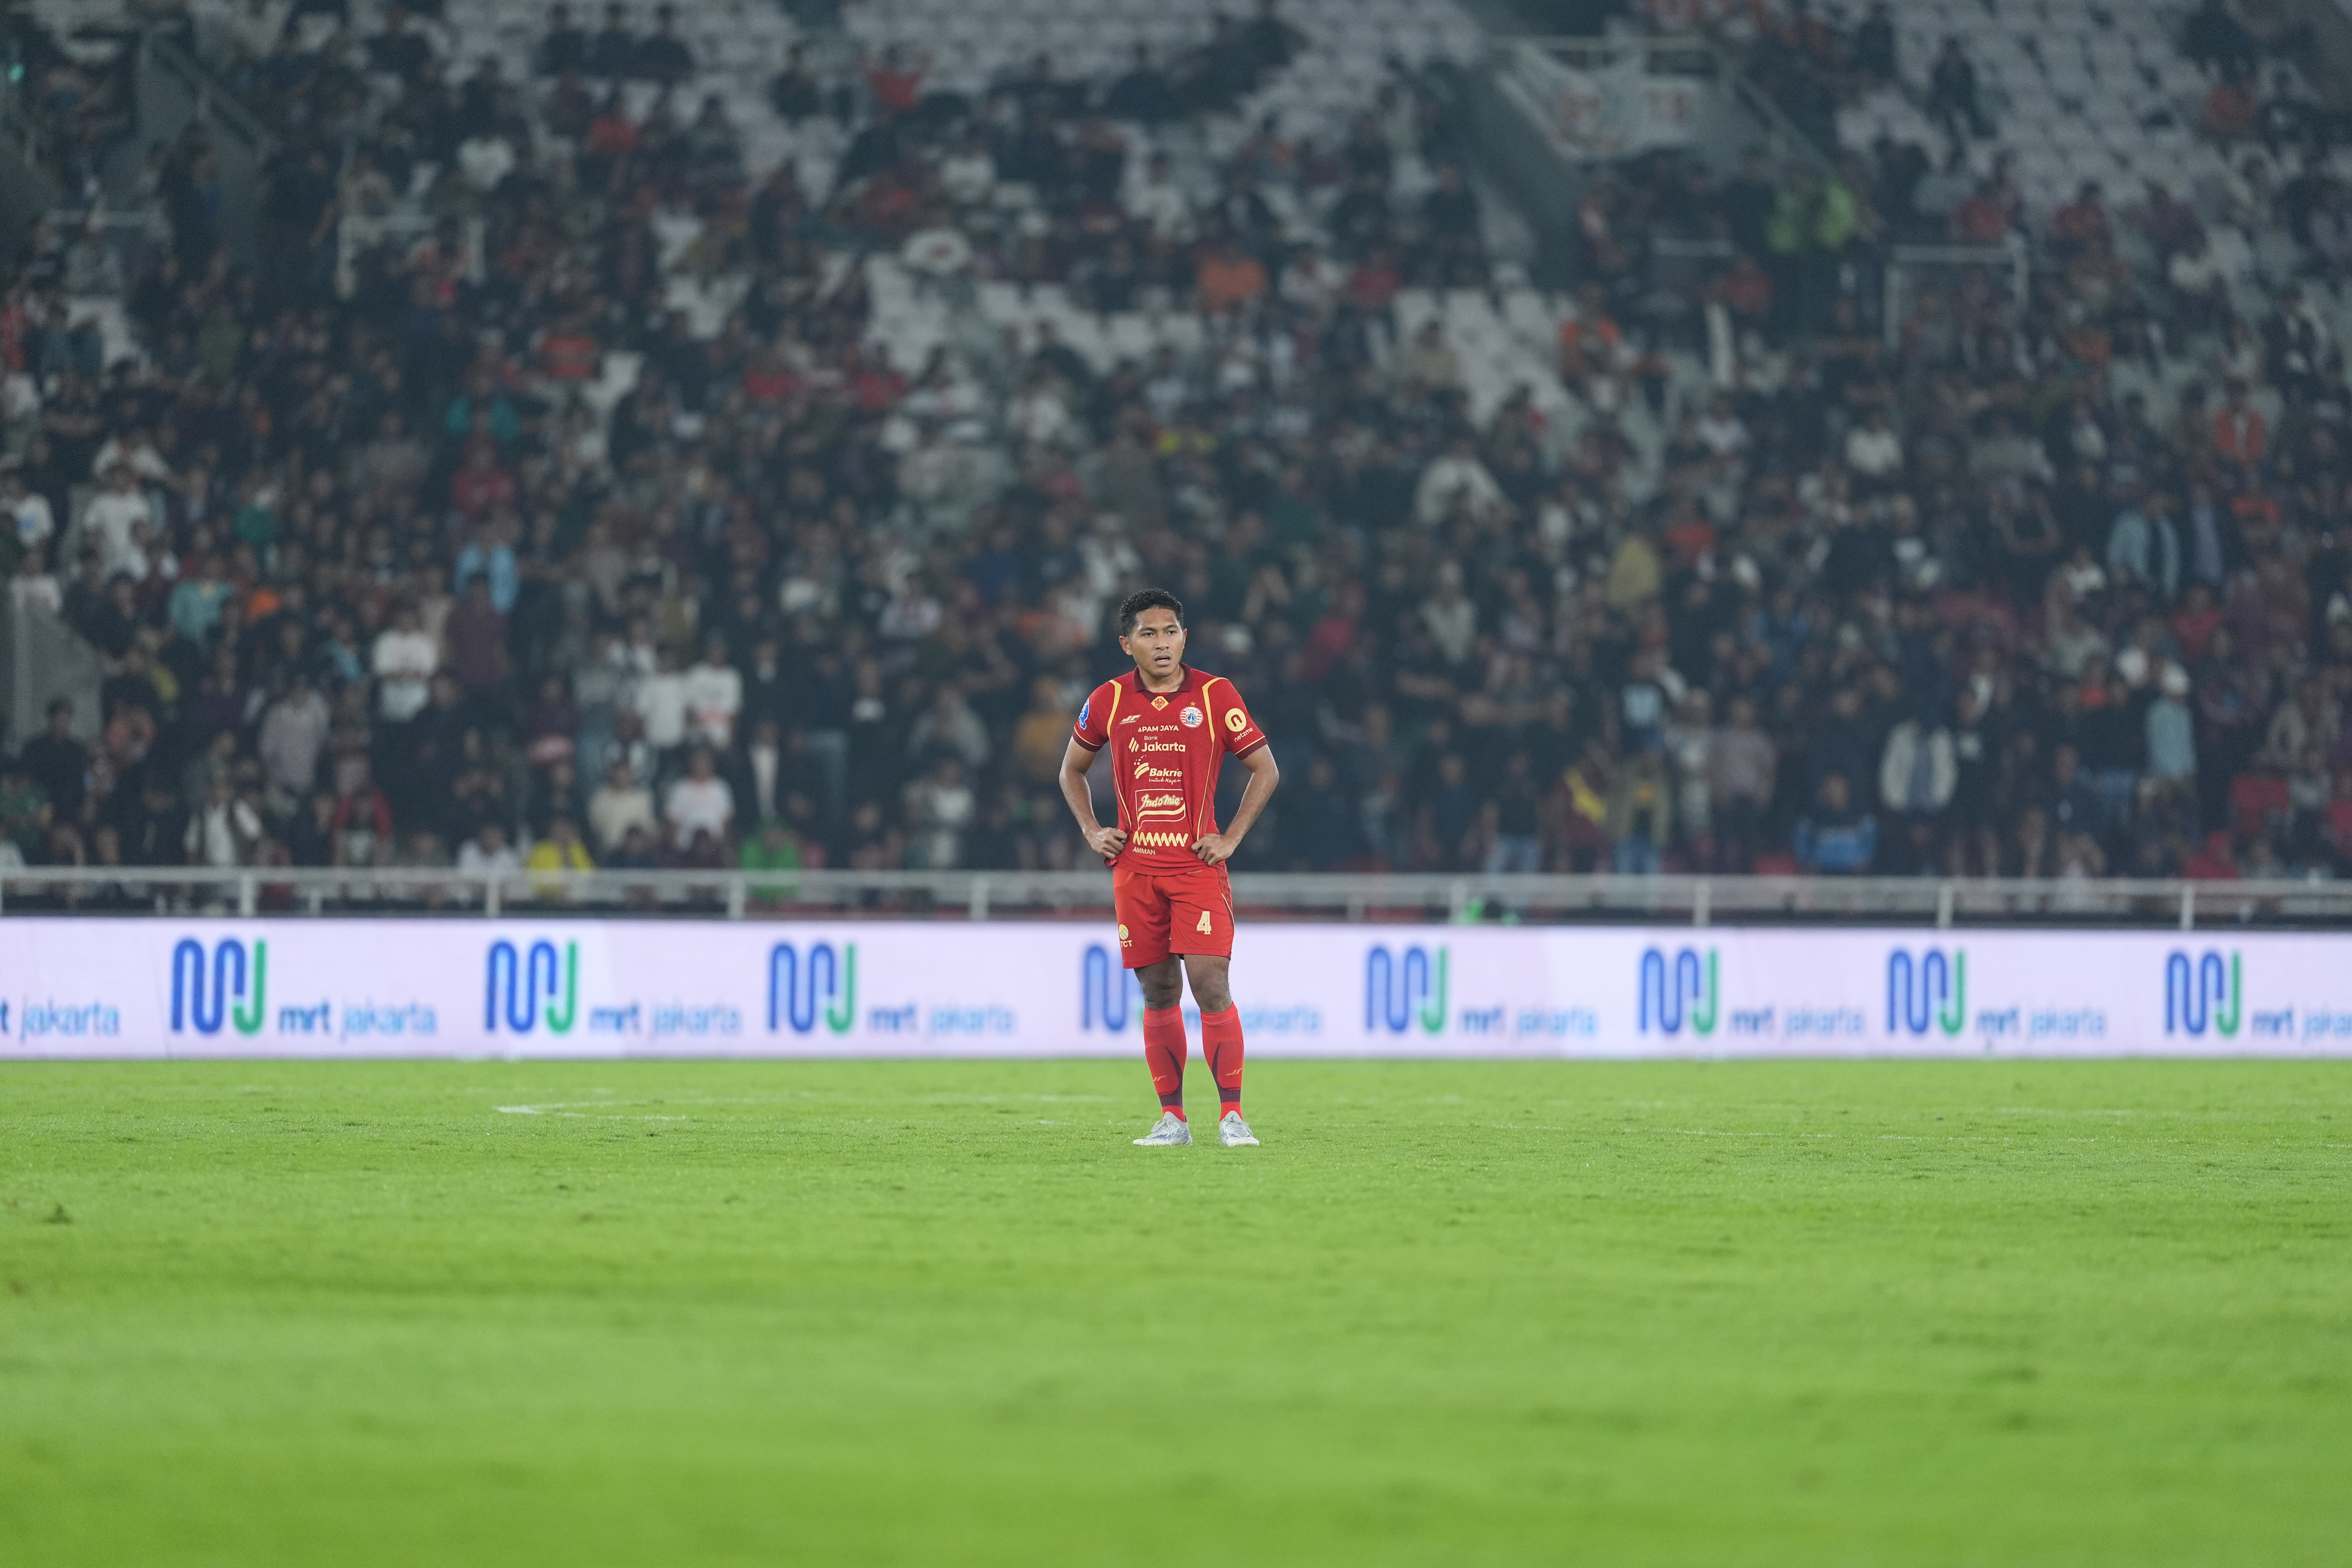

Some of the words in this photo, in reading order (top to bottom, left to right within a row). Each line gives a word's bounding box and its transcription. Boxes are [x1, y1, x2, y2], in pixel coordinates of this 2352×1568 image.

[1234, 727, 1253, 742] netzme
[1141, 742, 1186, 752] Jakarta
[1149, 768, 1183, 777] Bakrie
[1132, 847, 1156, 855] AMMAN
[1197, 911, 1212, 935] 4
[278, 1000, 331, 1034] mrt
